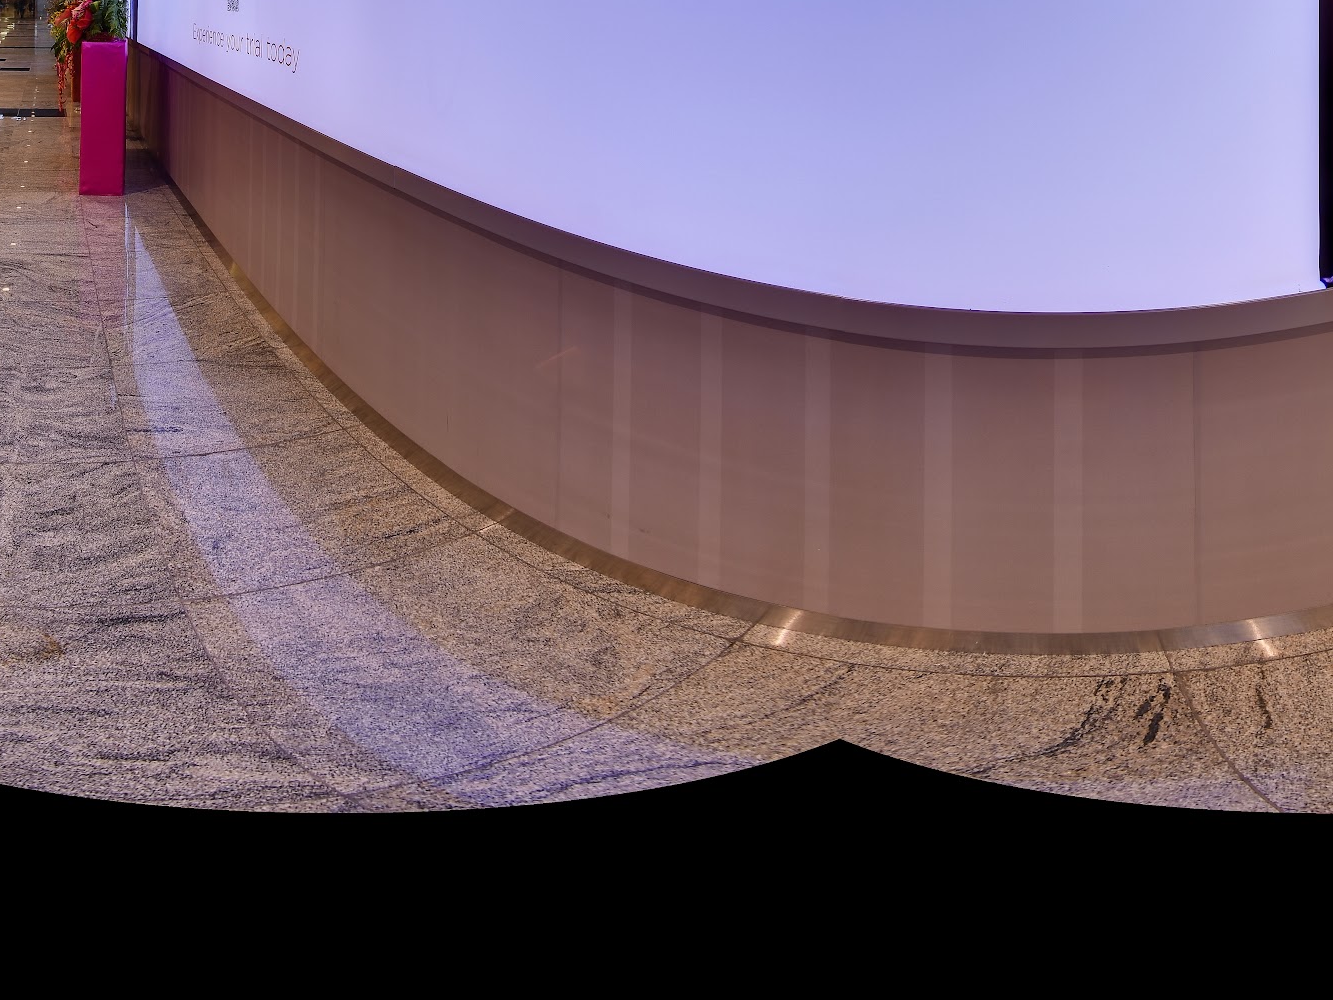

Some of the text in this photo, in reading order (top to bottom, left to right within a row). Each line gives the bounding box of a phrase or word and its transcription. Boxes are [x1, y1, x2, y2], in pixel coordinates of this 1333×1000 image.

[192, 22, 300, 74] Experience your trial today
